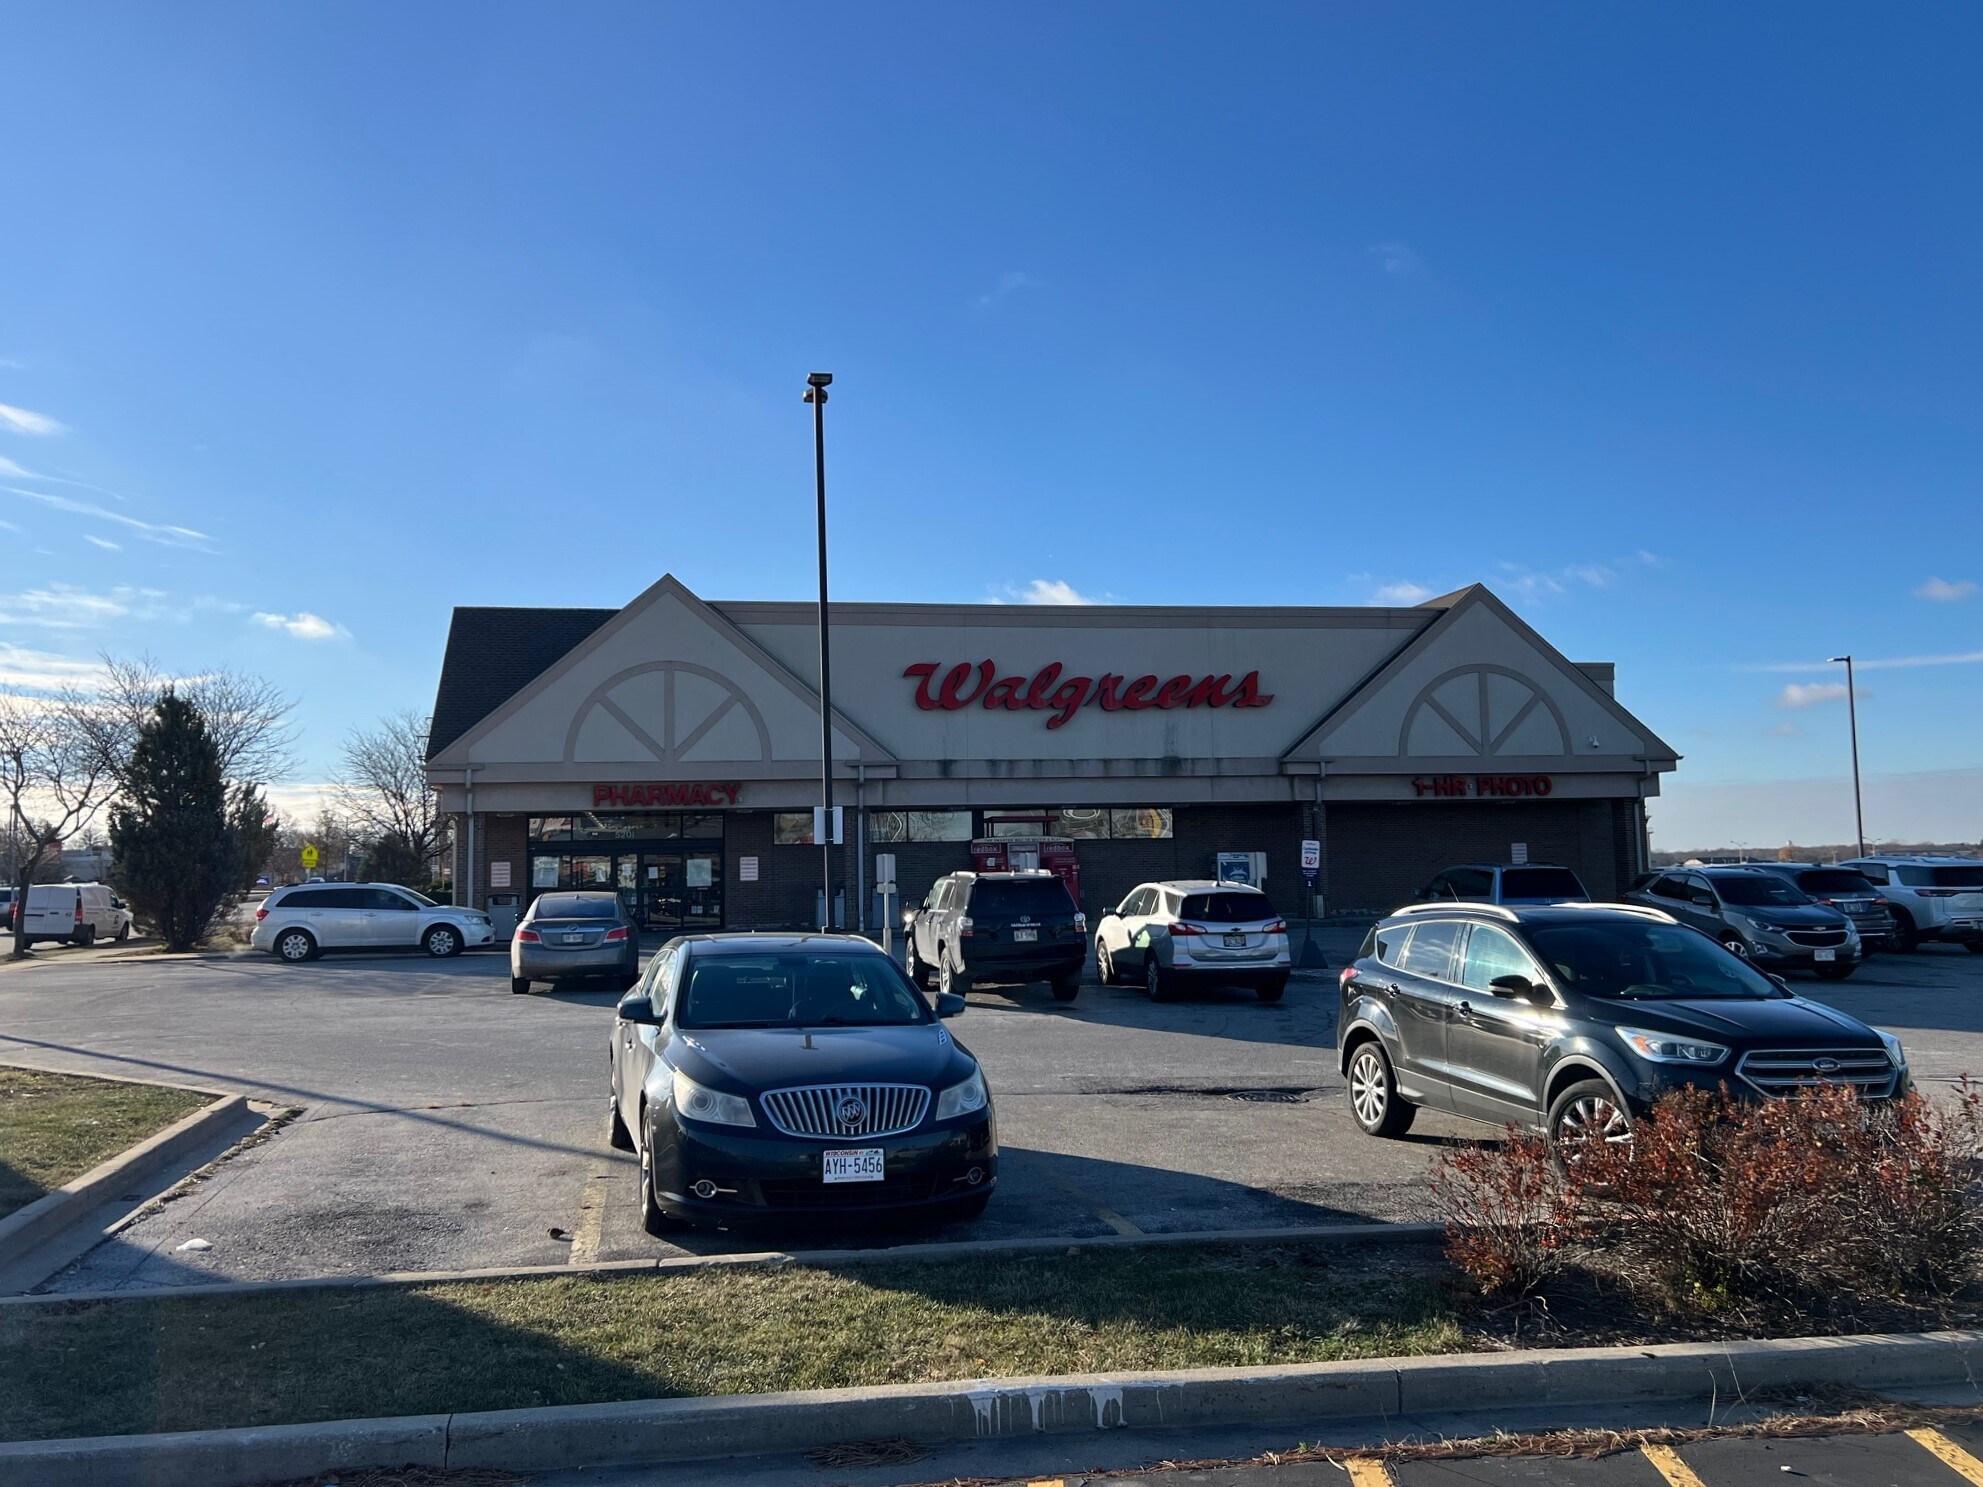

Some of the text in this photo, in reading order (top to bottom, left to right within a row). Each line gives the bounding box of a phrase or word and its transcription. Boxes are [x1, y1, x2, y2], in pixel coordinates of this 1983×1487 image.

[903, 658, 1275, 730] Walgreens
[593, 783, 741, 808] PHARMACY
[1412, 776, 1552, 797] 1-HR PHOTO
[615, 831, 635, 839] 5201
[825, 1157, 883, 1174] AYH-5456
